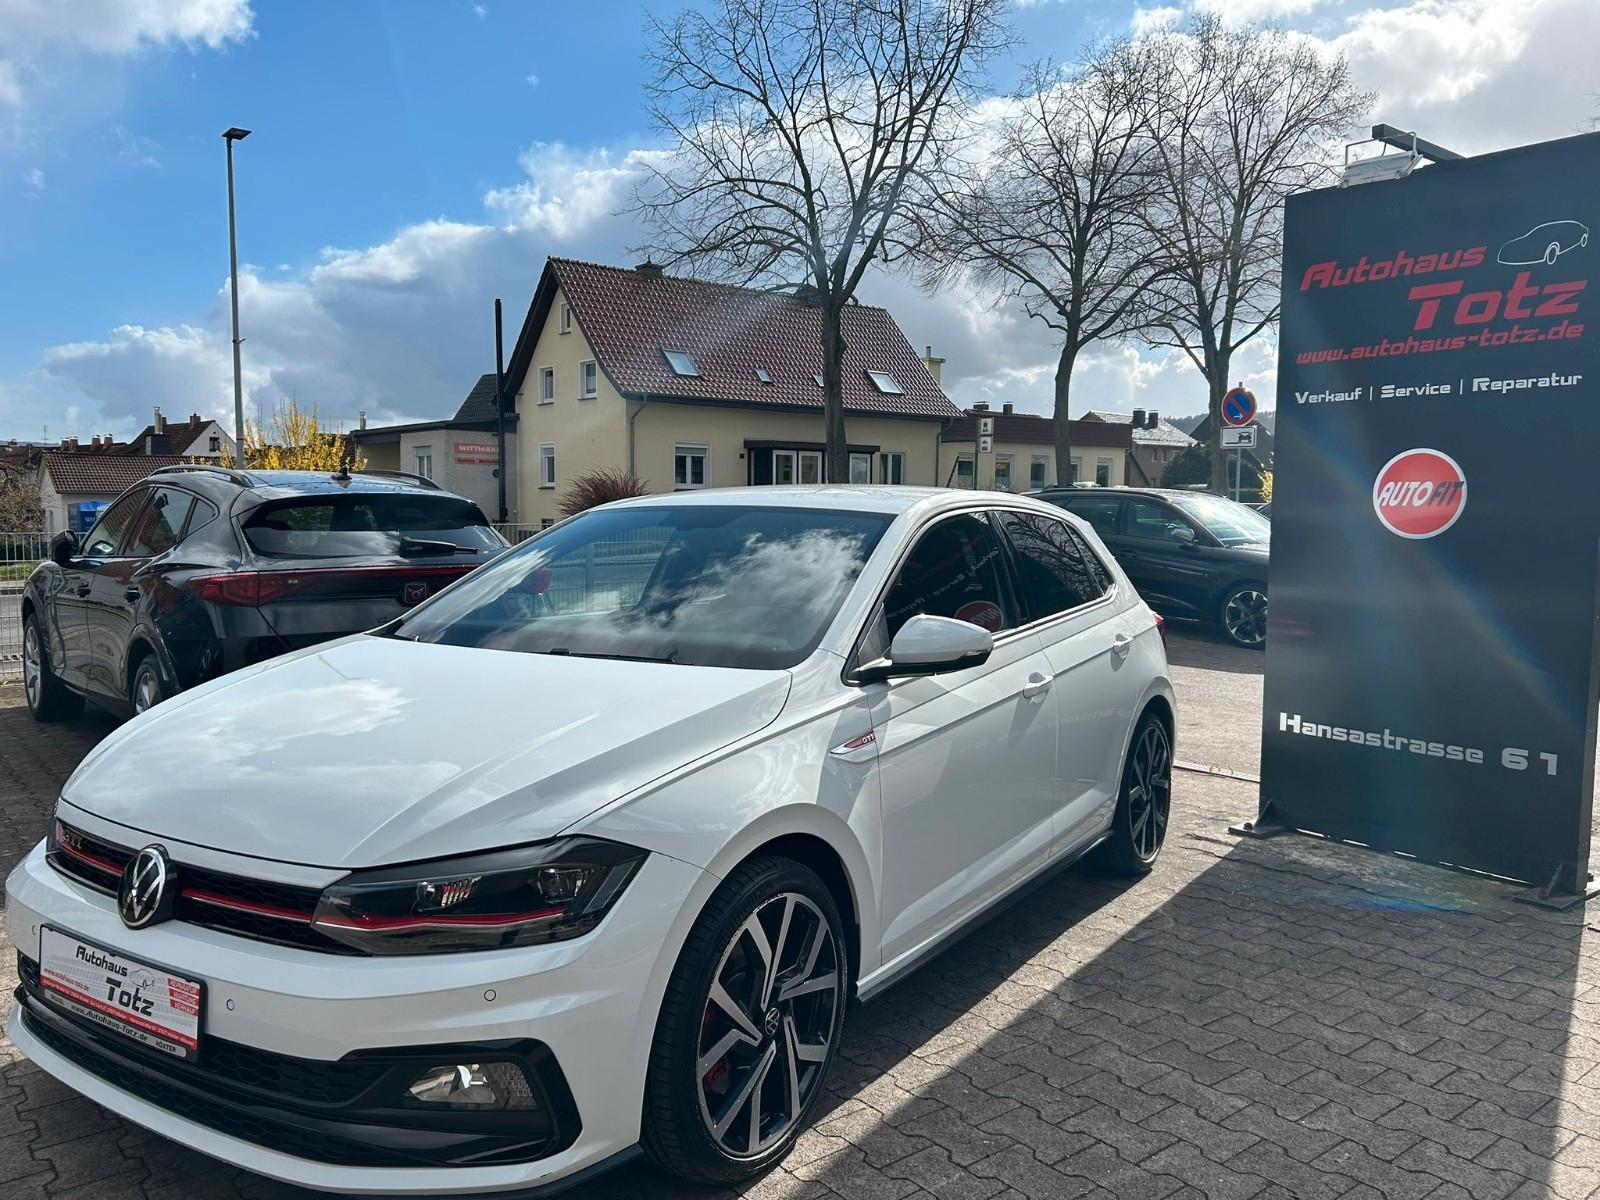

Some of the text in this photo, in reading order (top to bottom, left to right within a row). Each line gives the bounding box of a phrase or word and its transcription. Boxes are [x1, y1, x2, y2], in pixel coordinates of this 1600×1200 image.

[1299, 245, 1488, 292] Autohaus
[1407, 271, 1588, 331] Totz
[1295, 319, 1585, 365] www.autohaus-totz.de
[1295, 371, 1583, 404] Verkauf Service Reparatur
[1379, 480, 1465, 507] AUTOFIT
[1279, 711, 1484, 765] Hansastrasse
[76, 944, 128, 977] Autohaus
[106, 976, 155, 1017] Totz
